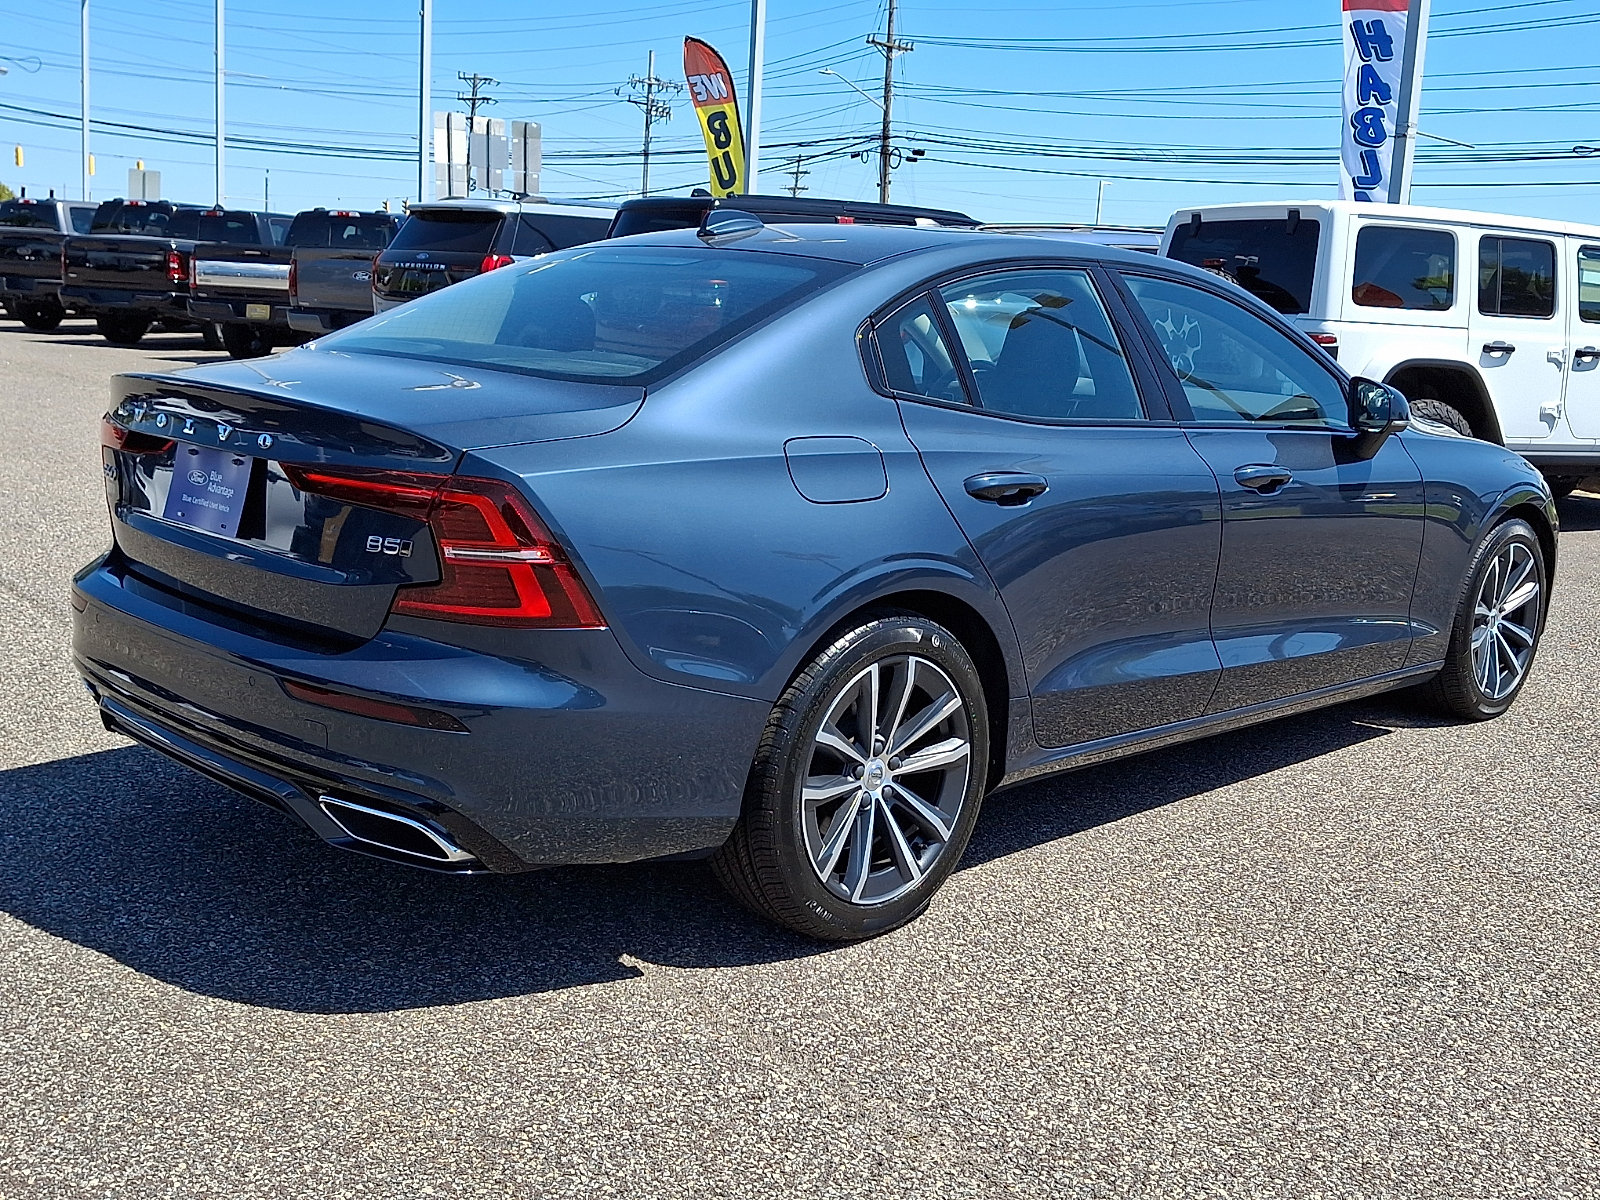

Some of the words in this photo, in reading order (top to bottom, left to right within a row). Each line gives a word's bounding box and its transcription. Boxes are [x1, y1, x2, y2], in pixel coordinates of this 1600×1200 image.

[395, 262, 446, 270] EXPEDITION
[134, 407, 274, 450] VOLVO
[189, 471, 206, 484] Ford
[209, 470, 223, 482] Blue
[207, 482, 234, 498] Advantage
[181, 494, 191, 502] Blue
[192, 496, 209, 507] Certified
[366, 535, 396, 556] B5
